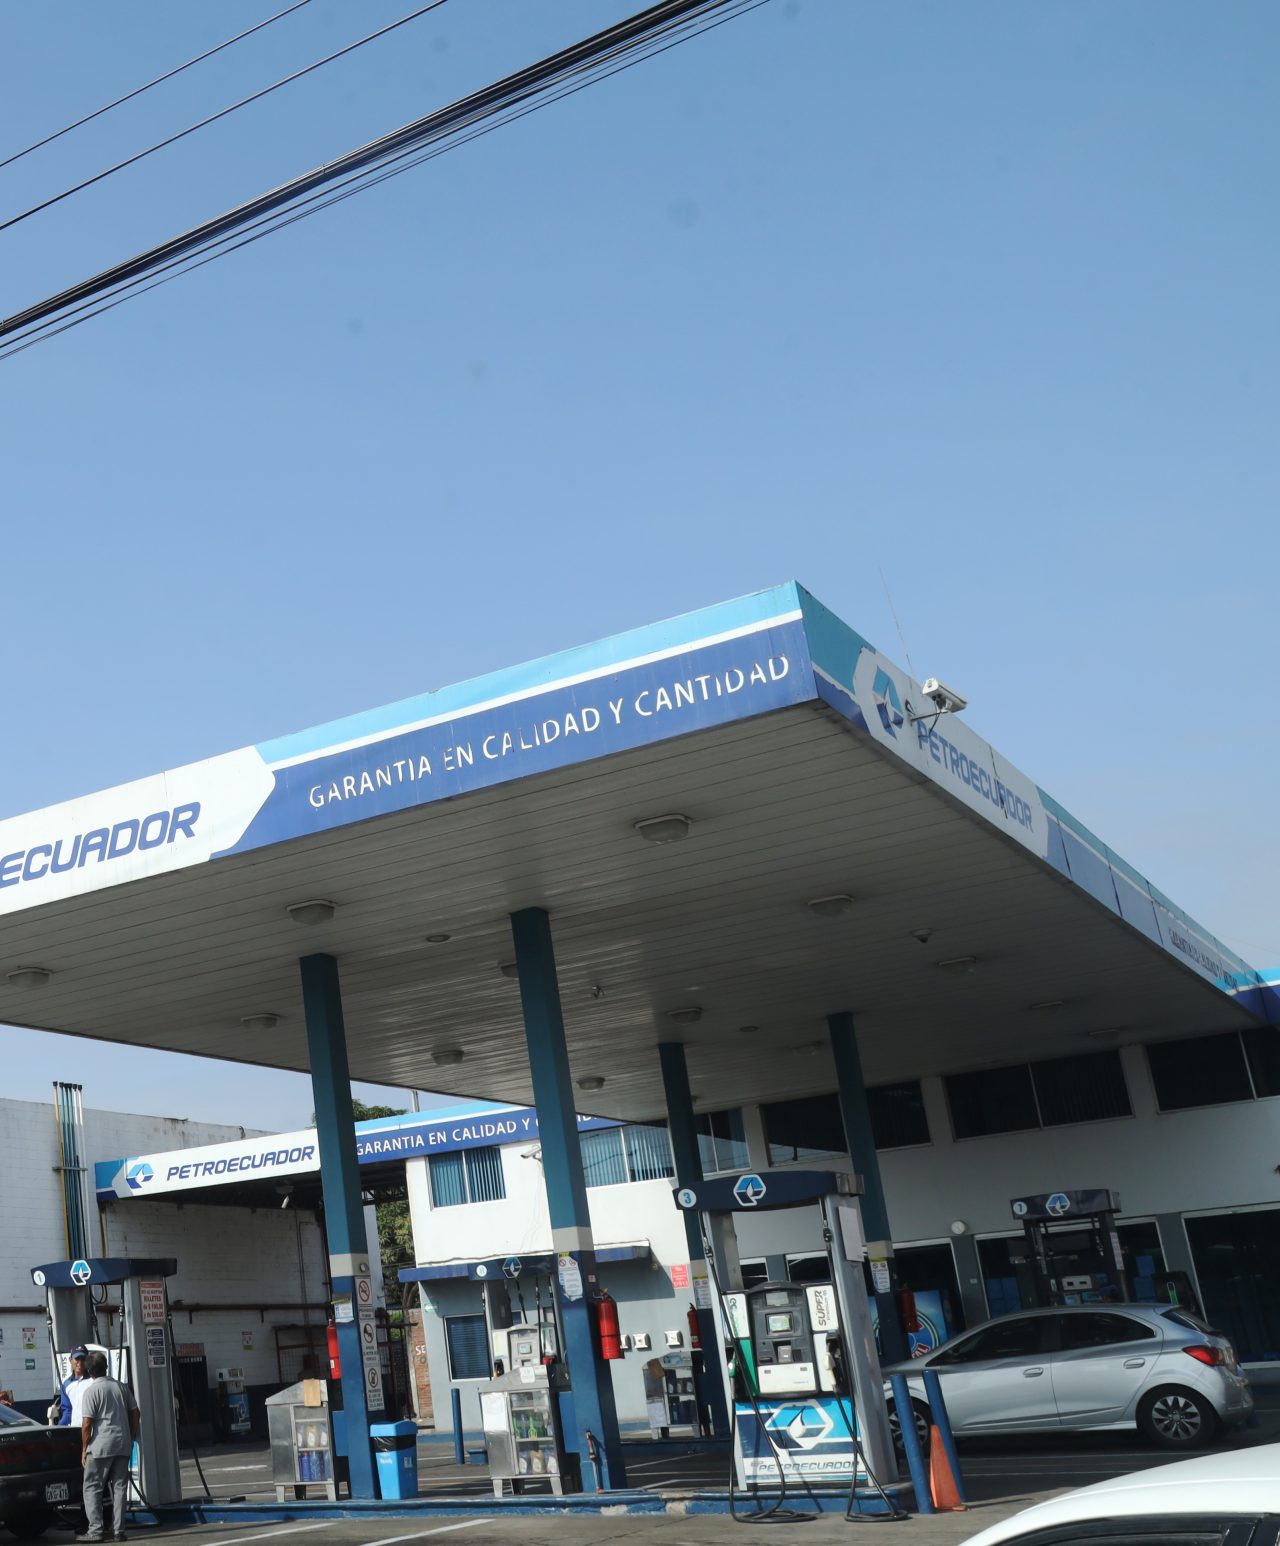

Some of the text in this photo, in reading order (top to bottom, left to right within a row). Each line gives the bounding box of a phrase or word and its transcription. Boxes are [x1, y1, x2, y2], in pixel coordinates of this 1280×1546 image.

[309, 656, 789, 808] GARANTIA EN CALIDAD Y CANTIDAD
[356, 1134, 425, 1156] GARANTIA
[429, 1131, 448, 1145] EN
[452, 1121, 517, 1142] CALIDAD
[521, 1117, 531, 1130] Y
[166, 1145, 315, 1181] PETROECUADOR
[683, 1192, 692, 1204] 3
